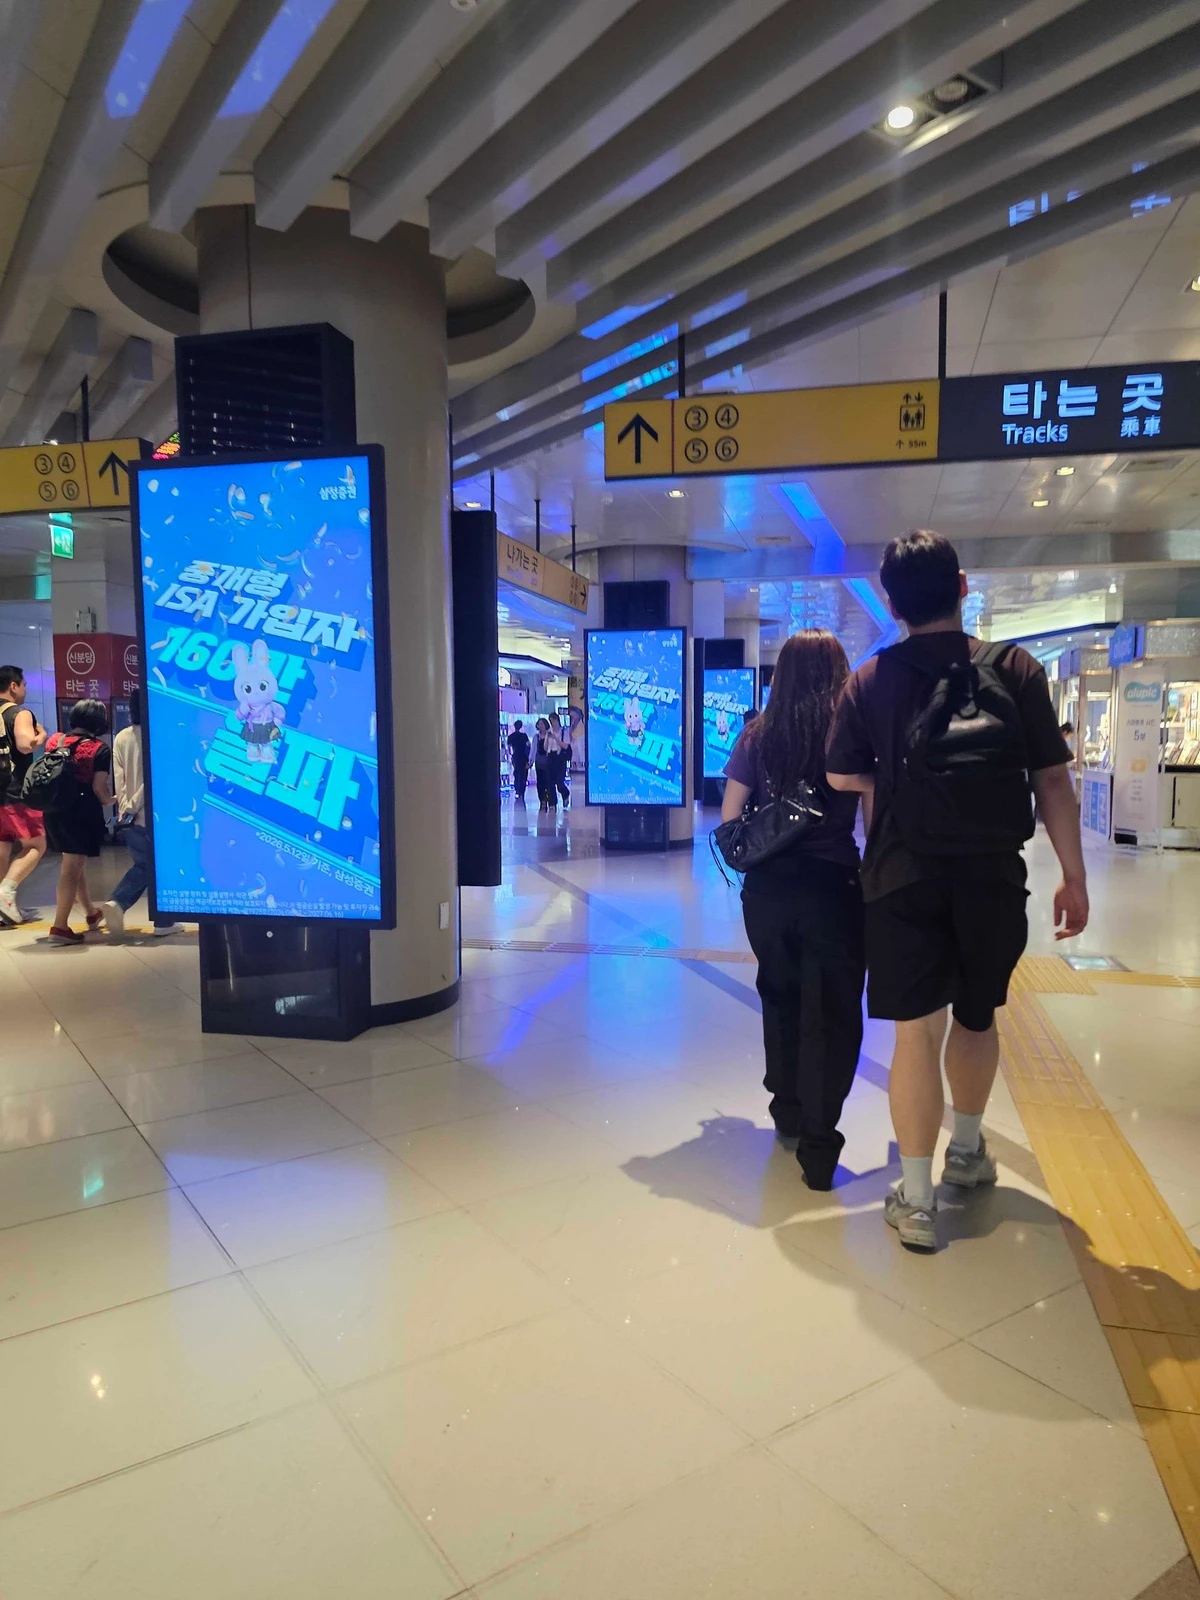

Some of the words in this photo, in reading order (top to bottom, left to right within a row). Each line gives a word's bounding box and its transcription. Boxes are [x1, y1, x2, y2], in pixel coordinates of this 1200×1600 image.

[1003, 380, 1098, 419] 타는
[1121, 373, 1164, 413] 곳
[1002, 420, 1068, 445] Tracks
[319, 486, 357, 500] 삼성증권
[507, 543, 530, 571] 나가는
[532, 556, 539, 575] 곳
[178, 559, 290, 598] 중개형
[155, 583, 219, 618] ISA
[228, 595, 362, 653] 가입자
[69, 651, 93, 664] 신분당
[65, 680, 85, 692] 타는
[89, 680, 99, 691] 곳
[334, 868, 375, 897] 삼성증권
